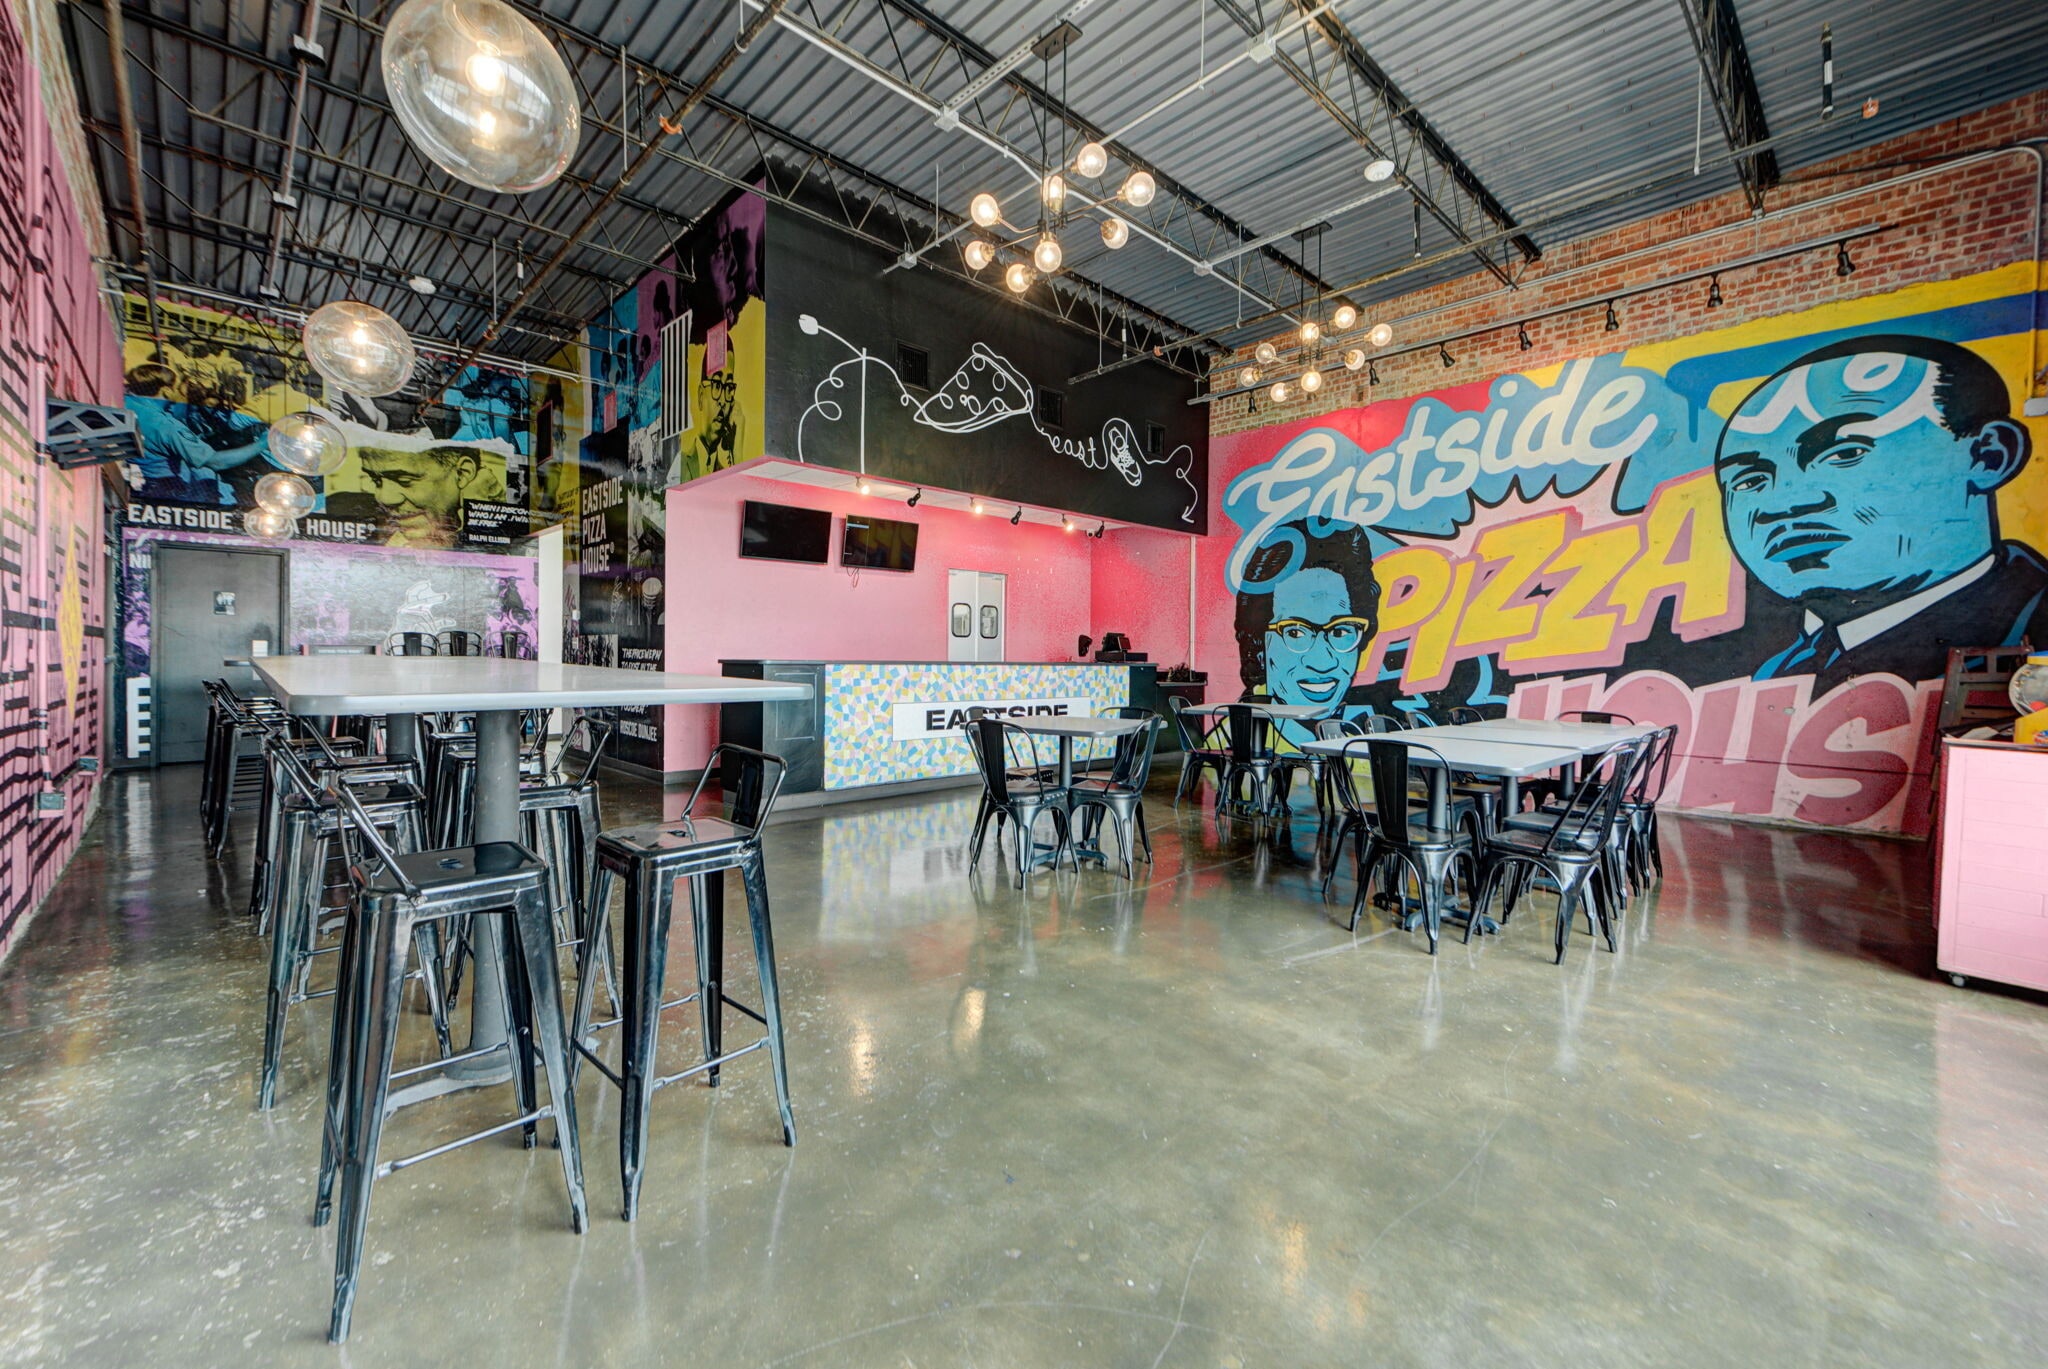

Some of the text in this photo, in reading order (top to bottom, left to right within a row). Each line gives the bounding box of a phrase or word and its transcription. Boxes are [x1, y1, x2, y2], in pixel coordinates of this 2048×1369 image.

[1052, 435, 1097, 468] east
[1228, 357, 1659, 586] Eastside
[582, 475, 624, 516] EASTSIDE
[127, 503, 234, 530] EASTSIDE
[582, 512, 607, 545] PIZZA
[1350, 467, 1744, 694] PIZZA
[926, 704, 1068, 731] EATSIDE
[1508, 670, 1944, 840] OUS
